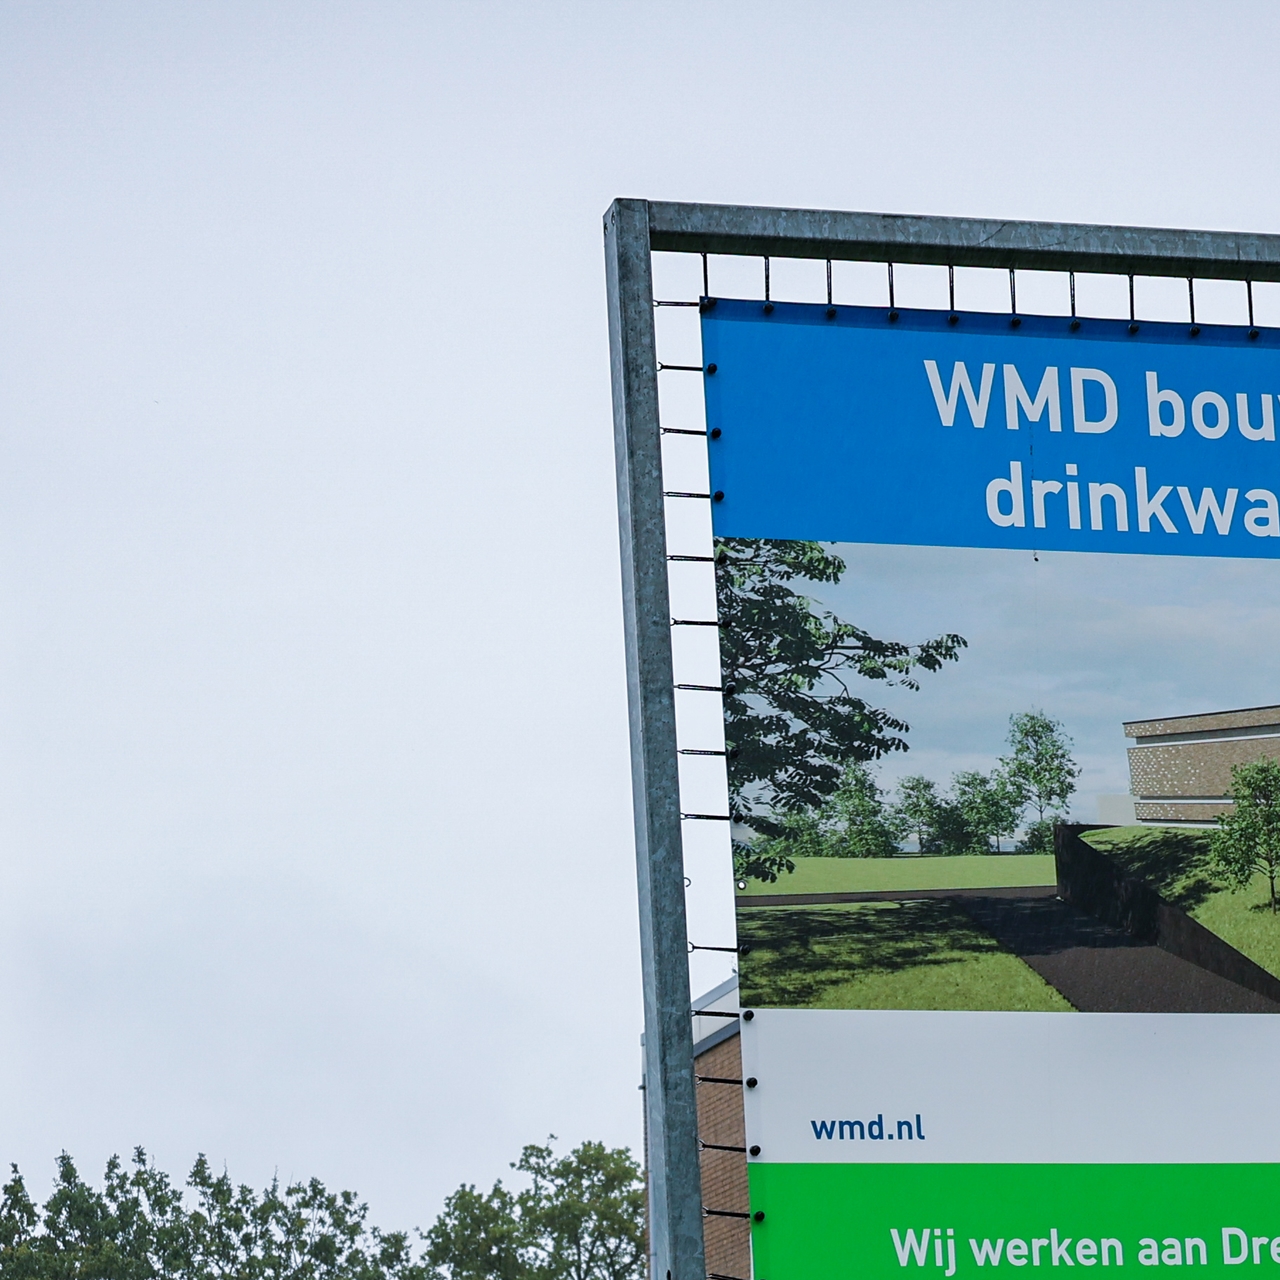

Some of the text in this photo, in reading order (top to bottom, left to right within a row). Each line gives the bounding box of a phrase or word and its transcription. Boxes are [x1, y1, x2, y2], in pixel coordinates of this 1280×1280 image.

[923, 359, 1118, 434] WMD
[810, 1113, 926, 1141] wmd.nl
[890, 1228, 956, 1277] Wij
[969, 1228, 1124, 1267] werken
[1138, 1237, 1208, 1266] aan
